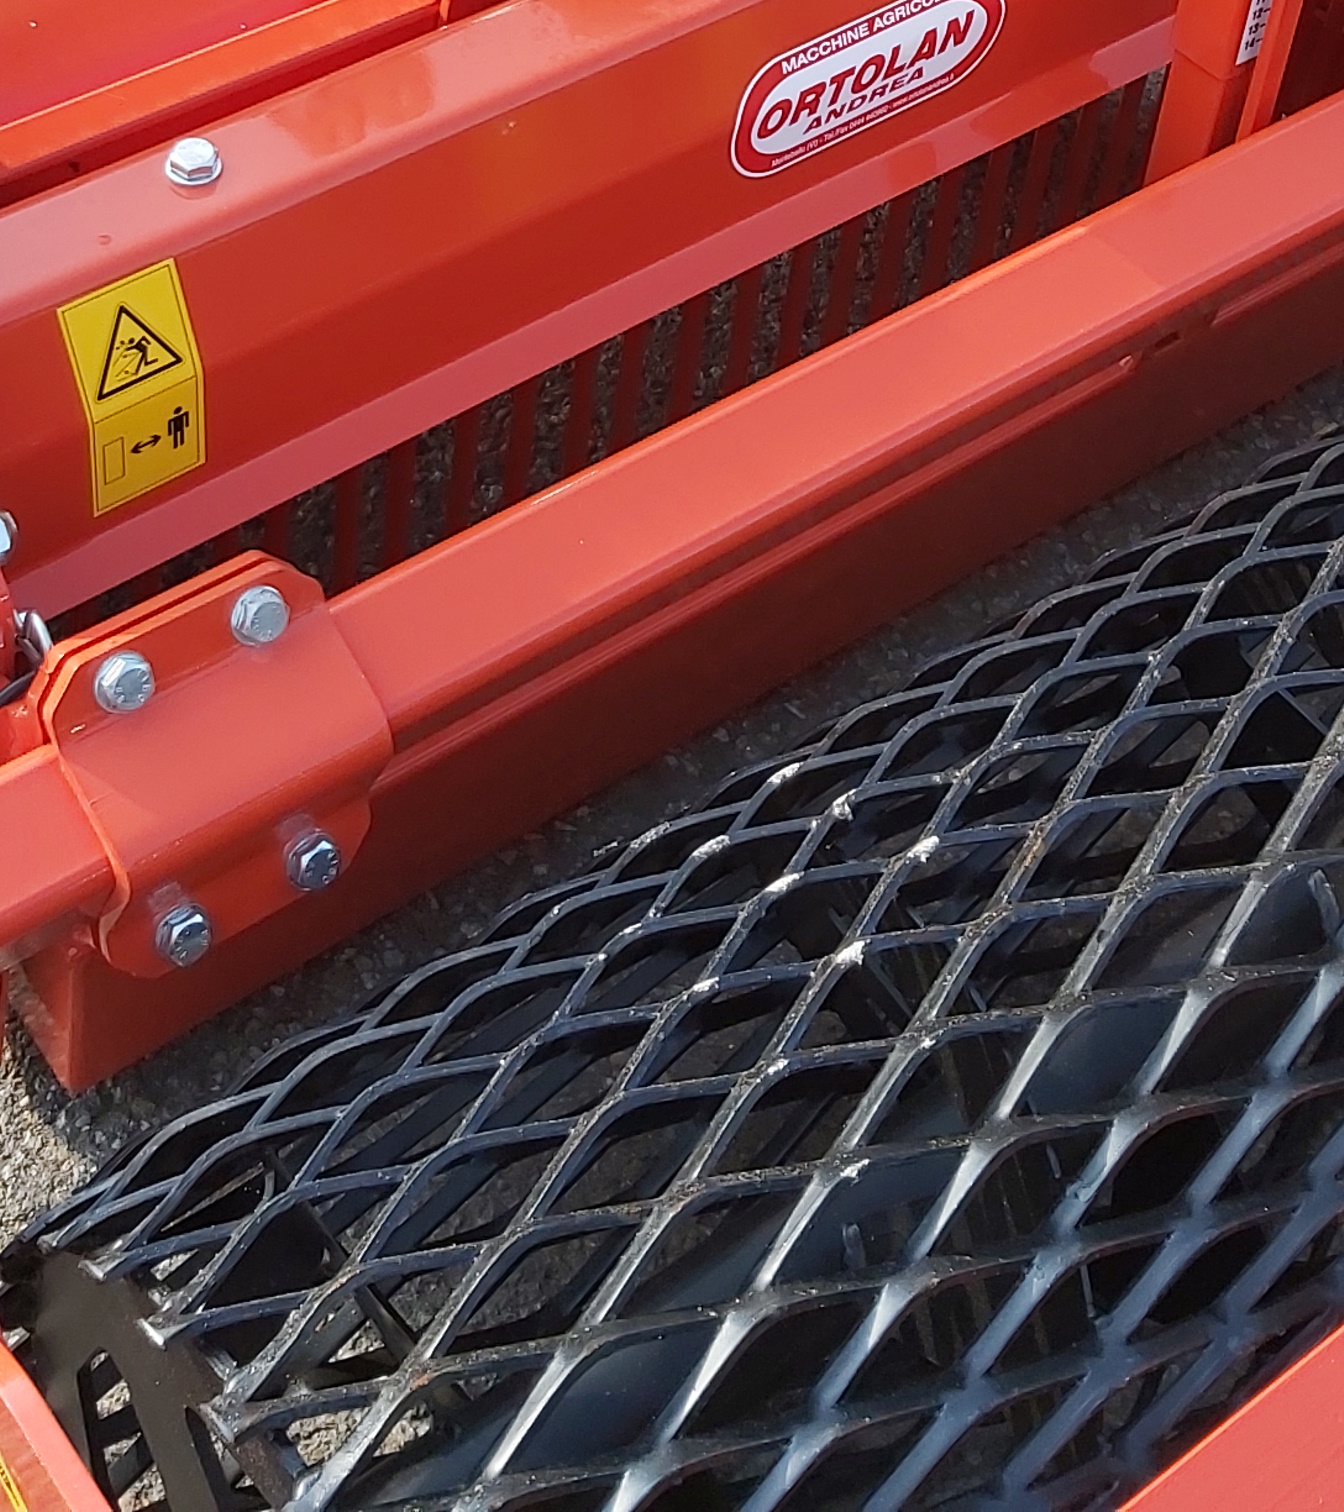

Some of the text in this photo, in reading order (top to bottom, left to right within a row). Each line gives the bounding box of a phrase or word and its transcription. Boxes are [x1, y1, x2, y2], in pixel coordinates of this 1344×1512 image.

[757, 9, 975, 140] ORTOLAN
[781, 22, 870, 75] MACCHINE
[1244, 37, 1256, 51] 14
[802, 66, 924, 136] ANDREA
